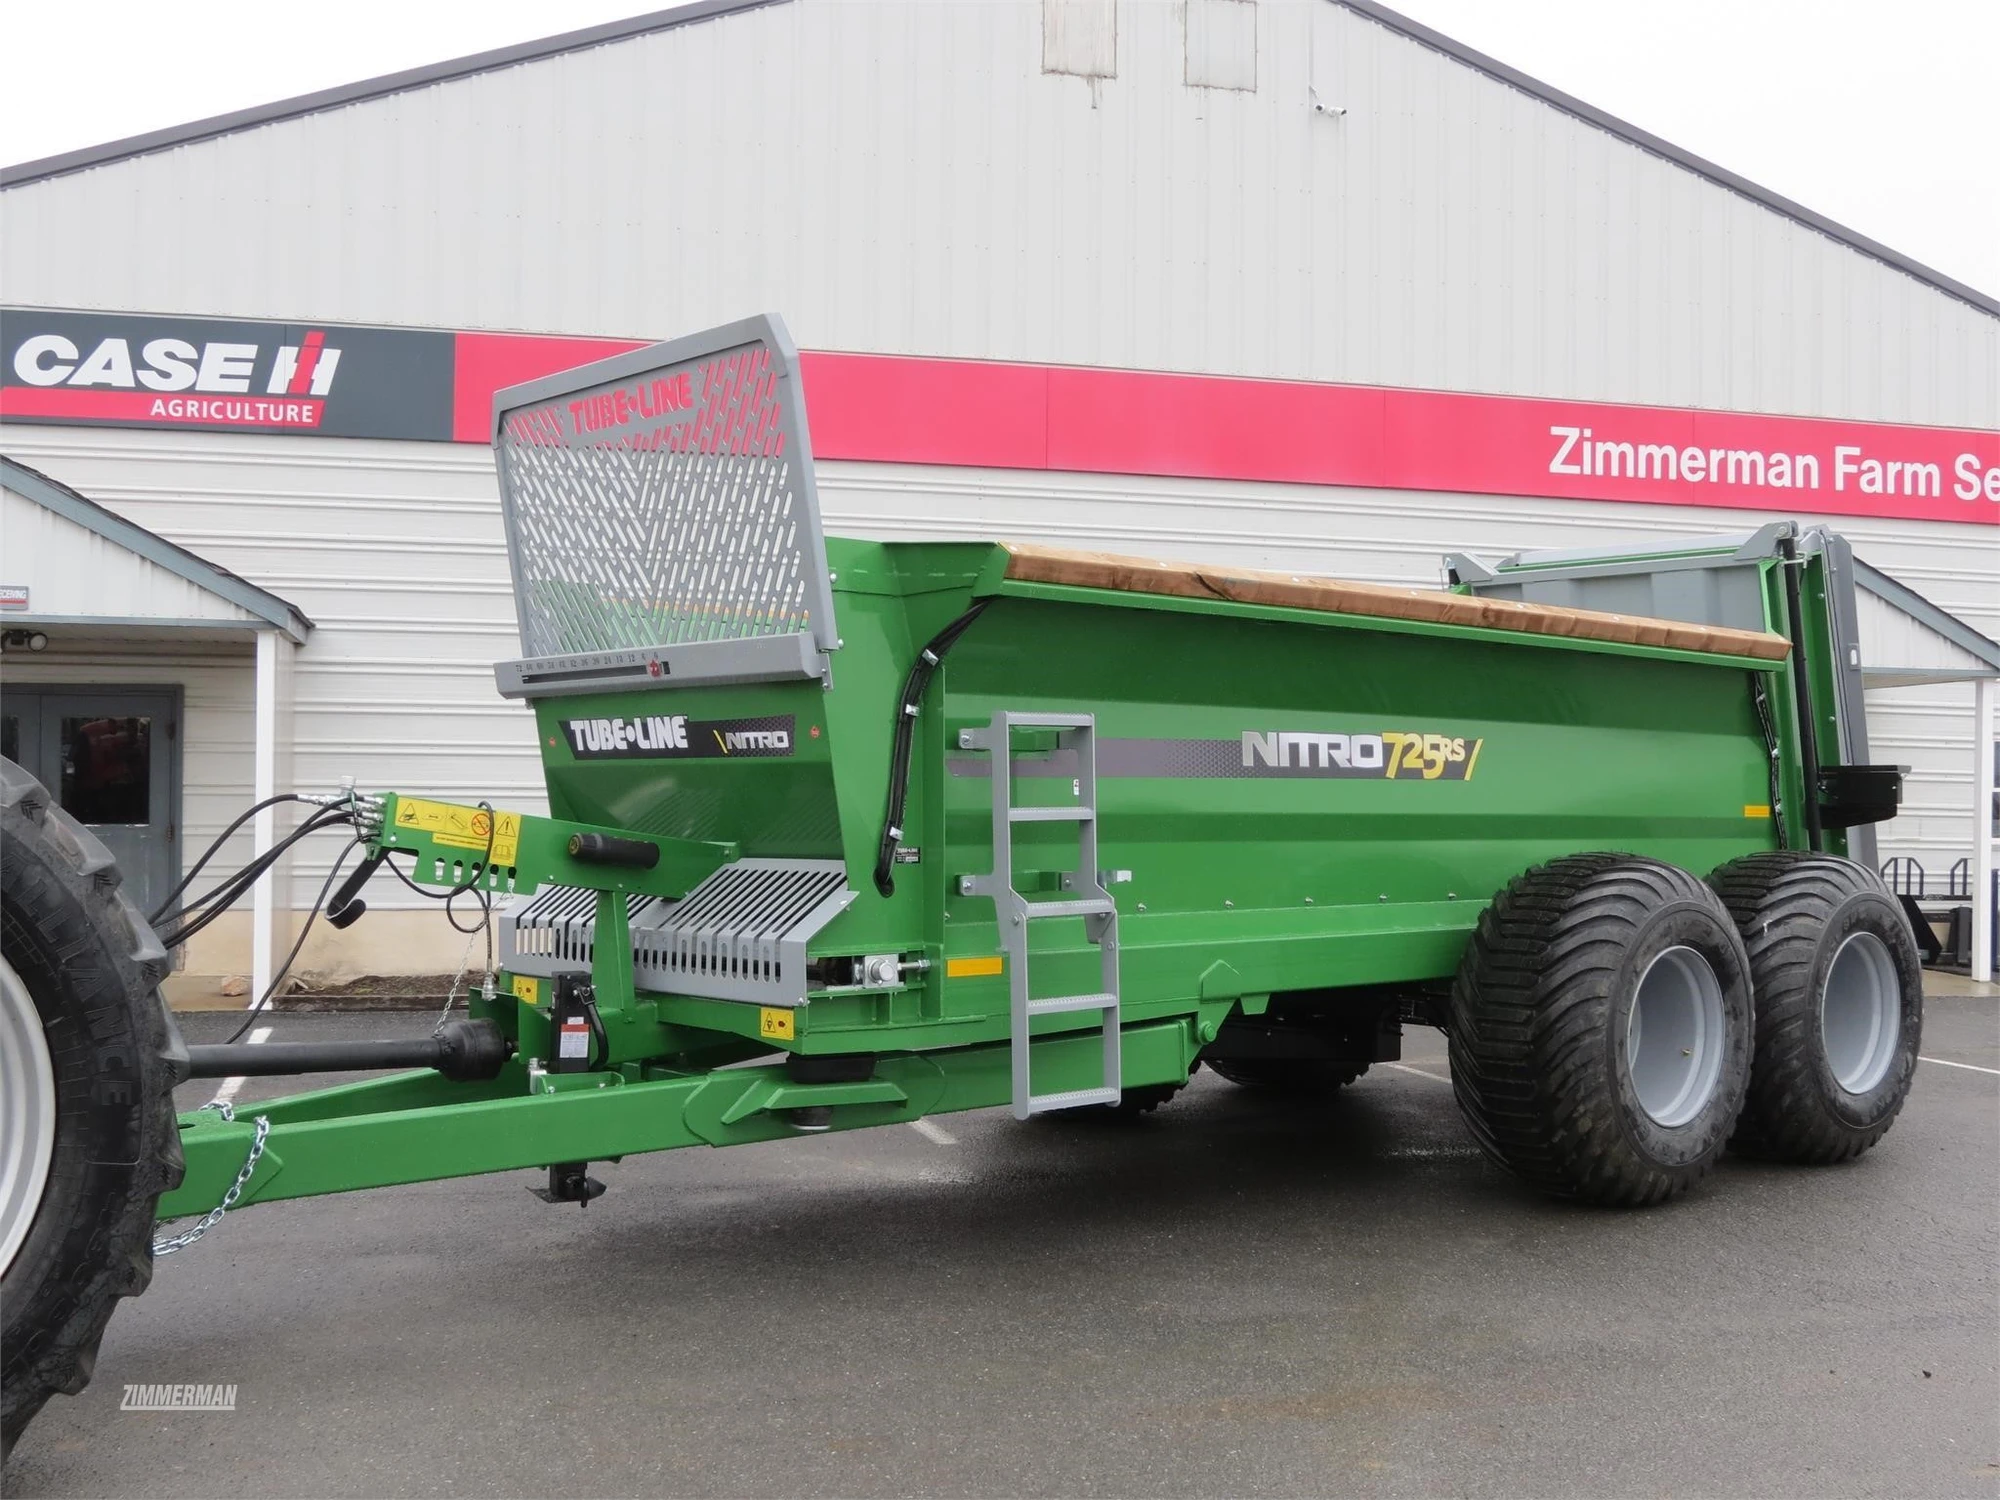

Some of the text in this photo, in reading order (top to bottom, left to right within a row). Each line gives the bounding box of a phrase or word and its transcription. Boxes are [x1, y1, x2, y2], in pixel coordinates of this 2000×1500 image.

[14, 334, 258, 393] CASE
[151, 399, 313, 423] AGRICULTURE
[1549, 426, 1819, 489] Zimmerman
[1834, 446, 1940, 497] Farm
[725, 731, 789, 750] NITRO
[1242, 731, 1383, 768] NITRO
